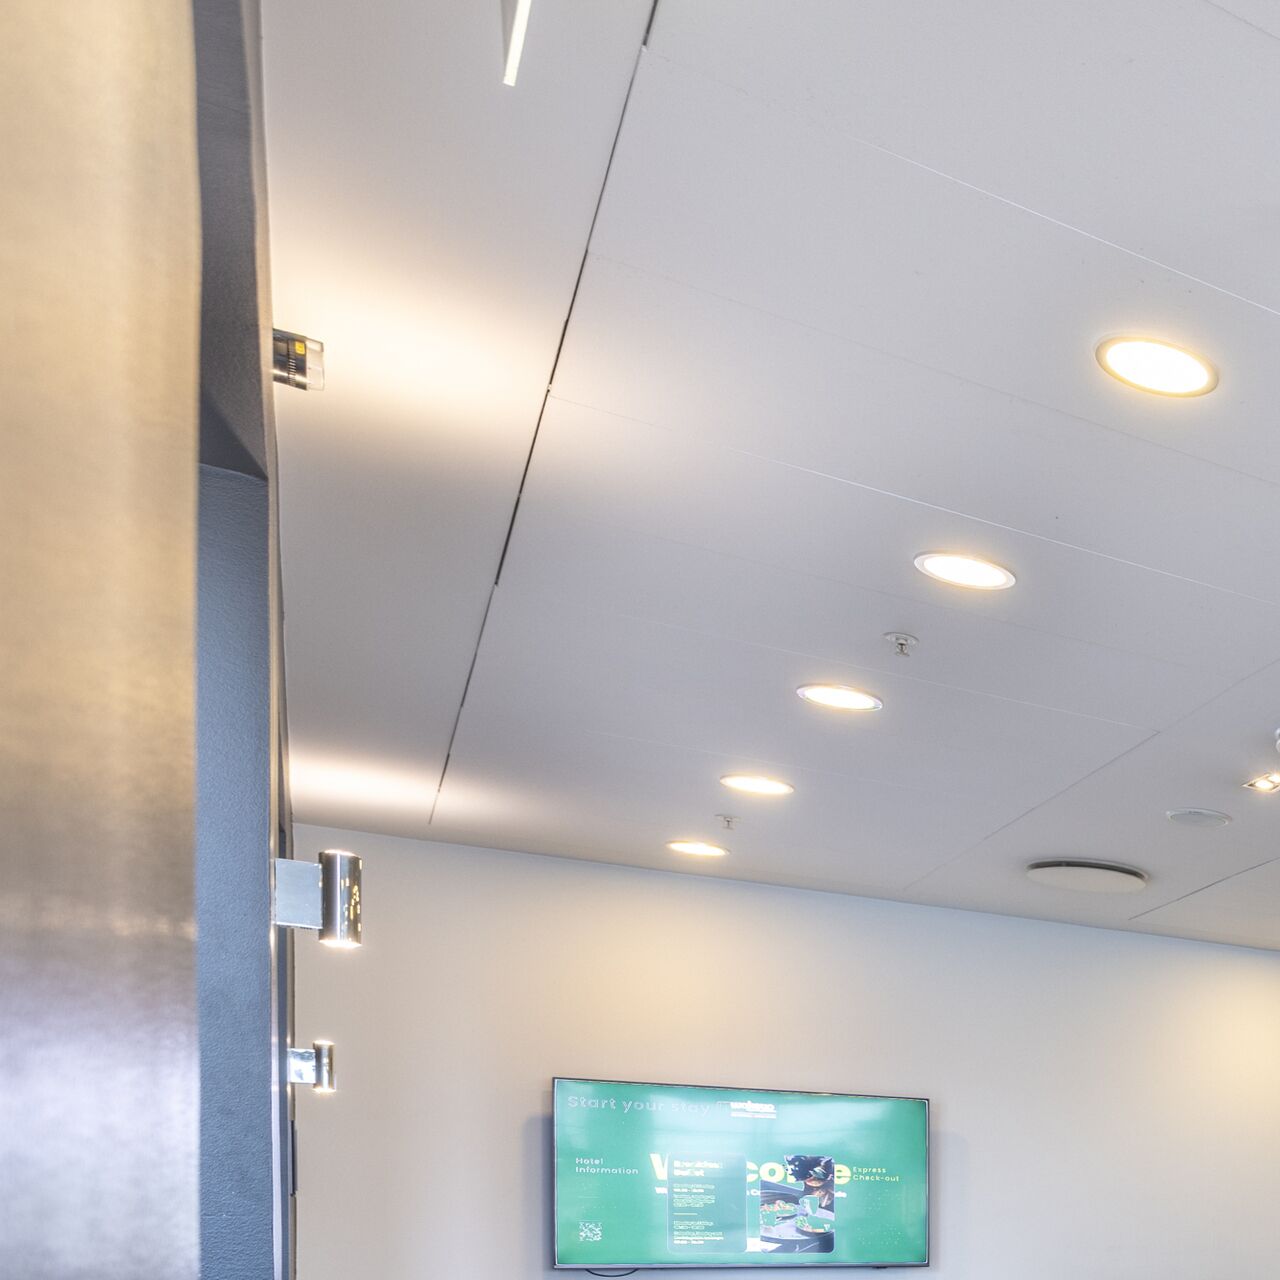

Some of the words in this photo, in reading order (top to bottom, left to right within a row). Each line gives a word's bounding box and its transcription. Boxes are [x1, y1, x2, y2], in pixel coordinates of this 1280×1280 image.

[567, 1095, 617, 1109] Start
[622, 1099, 664, 1114] your
[671, 1101, 710, 1115] stay
[575, 1157, 604, 1166] Hotel
[575, 1166, 639, 1175] Information
[852, 1166, 887, 1175] Express
[852, 1174, 900, 1182] Check-out
